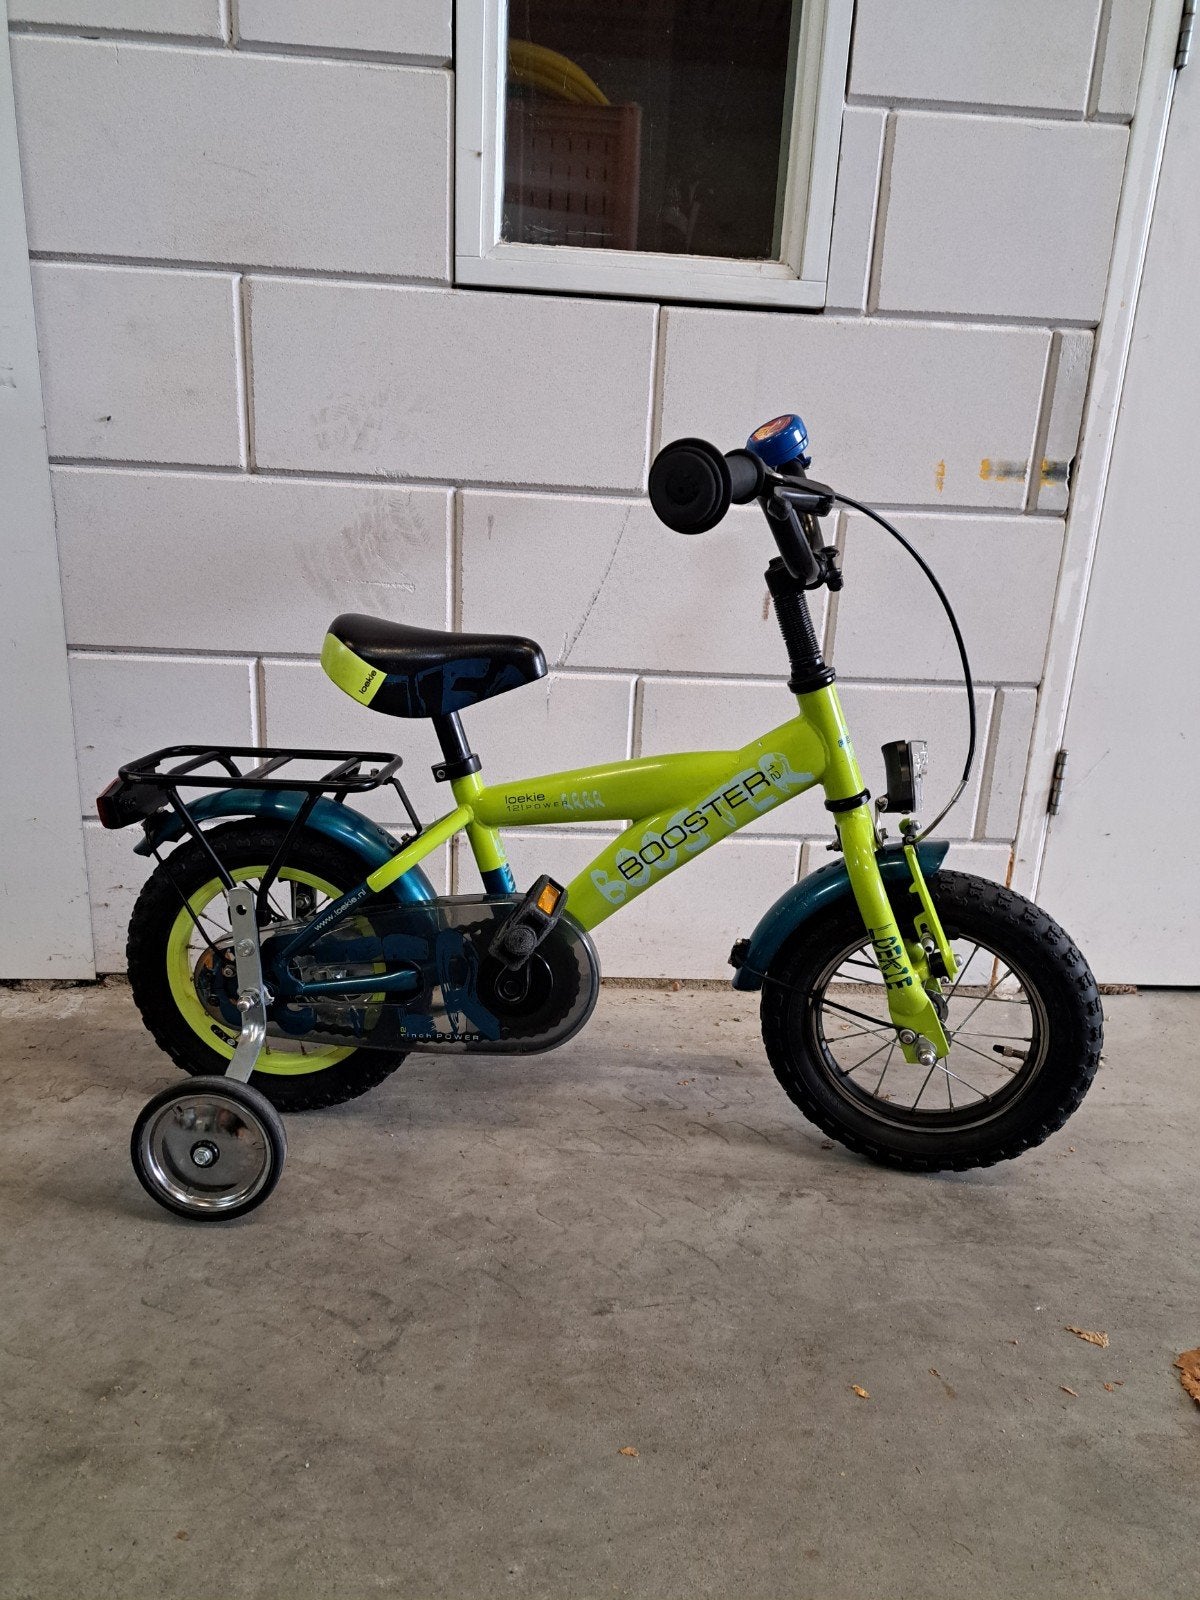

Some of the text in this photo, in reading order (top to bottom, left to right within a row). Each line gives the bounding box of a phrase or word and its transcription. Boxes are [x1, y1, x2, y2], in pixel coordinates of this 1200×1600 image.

[358, 670, 377, 695] loekie
[505, 792, 545, 804] loekie
[617, 764, 782, 880] BOOSTER 12
[313, 888, 367, 931] www.loekie.nl
